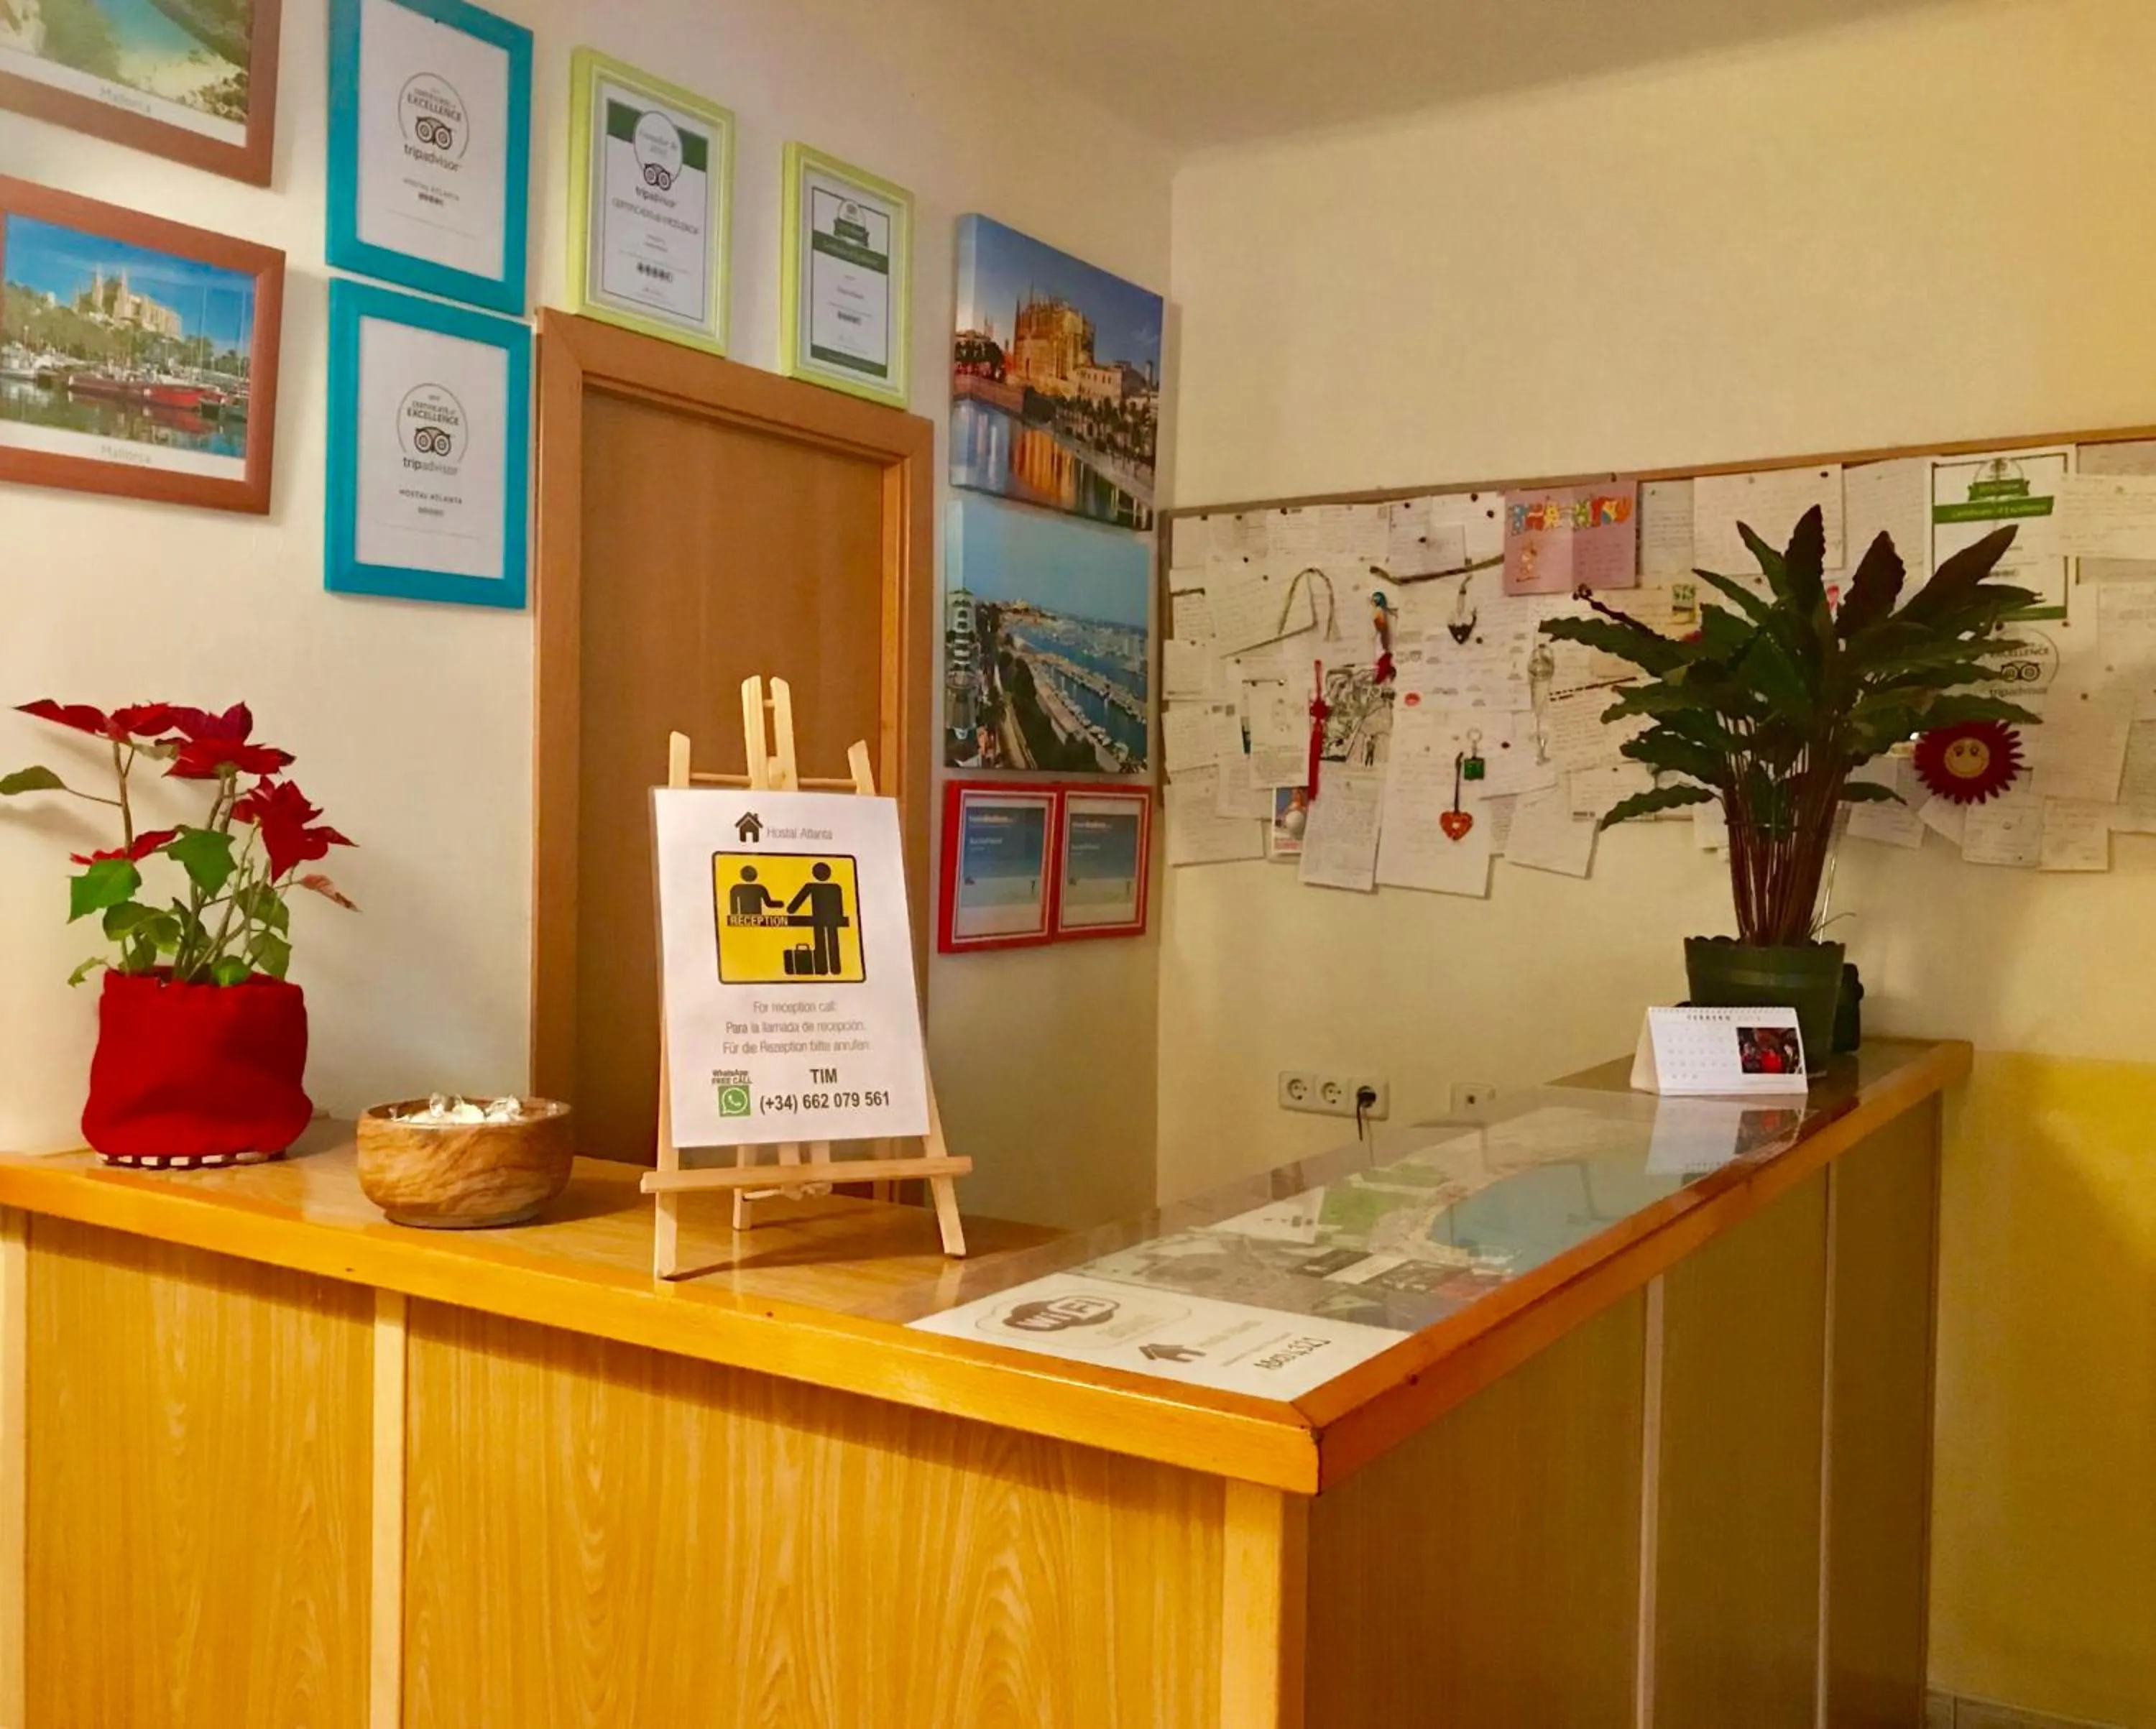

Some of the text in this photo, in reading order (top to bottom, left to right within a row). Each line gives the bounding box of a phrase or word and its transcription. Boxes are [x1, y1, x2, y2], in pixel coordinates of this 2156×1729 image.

[407, 92, 462, 123] EXCELLENCE
[404, 144, 460, 172] tripadvisor
[407, 407, 460, 426] EXCELLENCE
[402, 456, 459, 476] tripadvisor
[766, 827, 833, 840] Hostal Atlanta
[729, 915, 788, 926] RECEPTION
[753, 1001, 768, 1013] For
[771, 1002, 816, 1015] reception
[725, 1021, 748, 1033] Para
[751, 1021, 760, 1033] la
[761, 1021, 799, 1033] llamada
[801, 1020, 815, 1033] de
[722, 1040, 739, 1054] Für
[742, 1041, 757, 1053] die
[760, 1039, 807, 1054] Rezeption
[810, 1040, 831, 1052] bitte
[711, 1068, 749, 1078] WhatsApp
[711, 1076, 752, 1085] FREE CALL
[809, 1067, 839, 1084] TIM
[759, 1090, 890, 1115] (+34) 662 079 561
